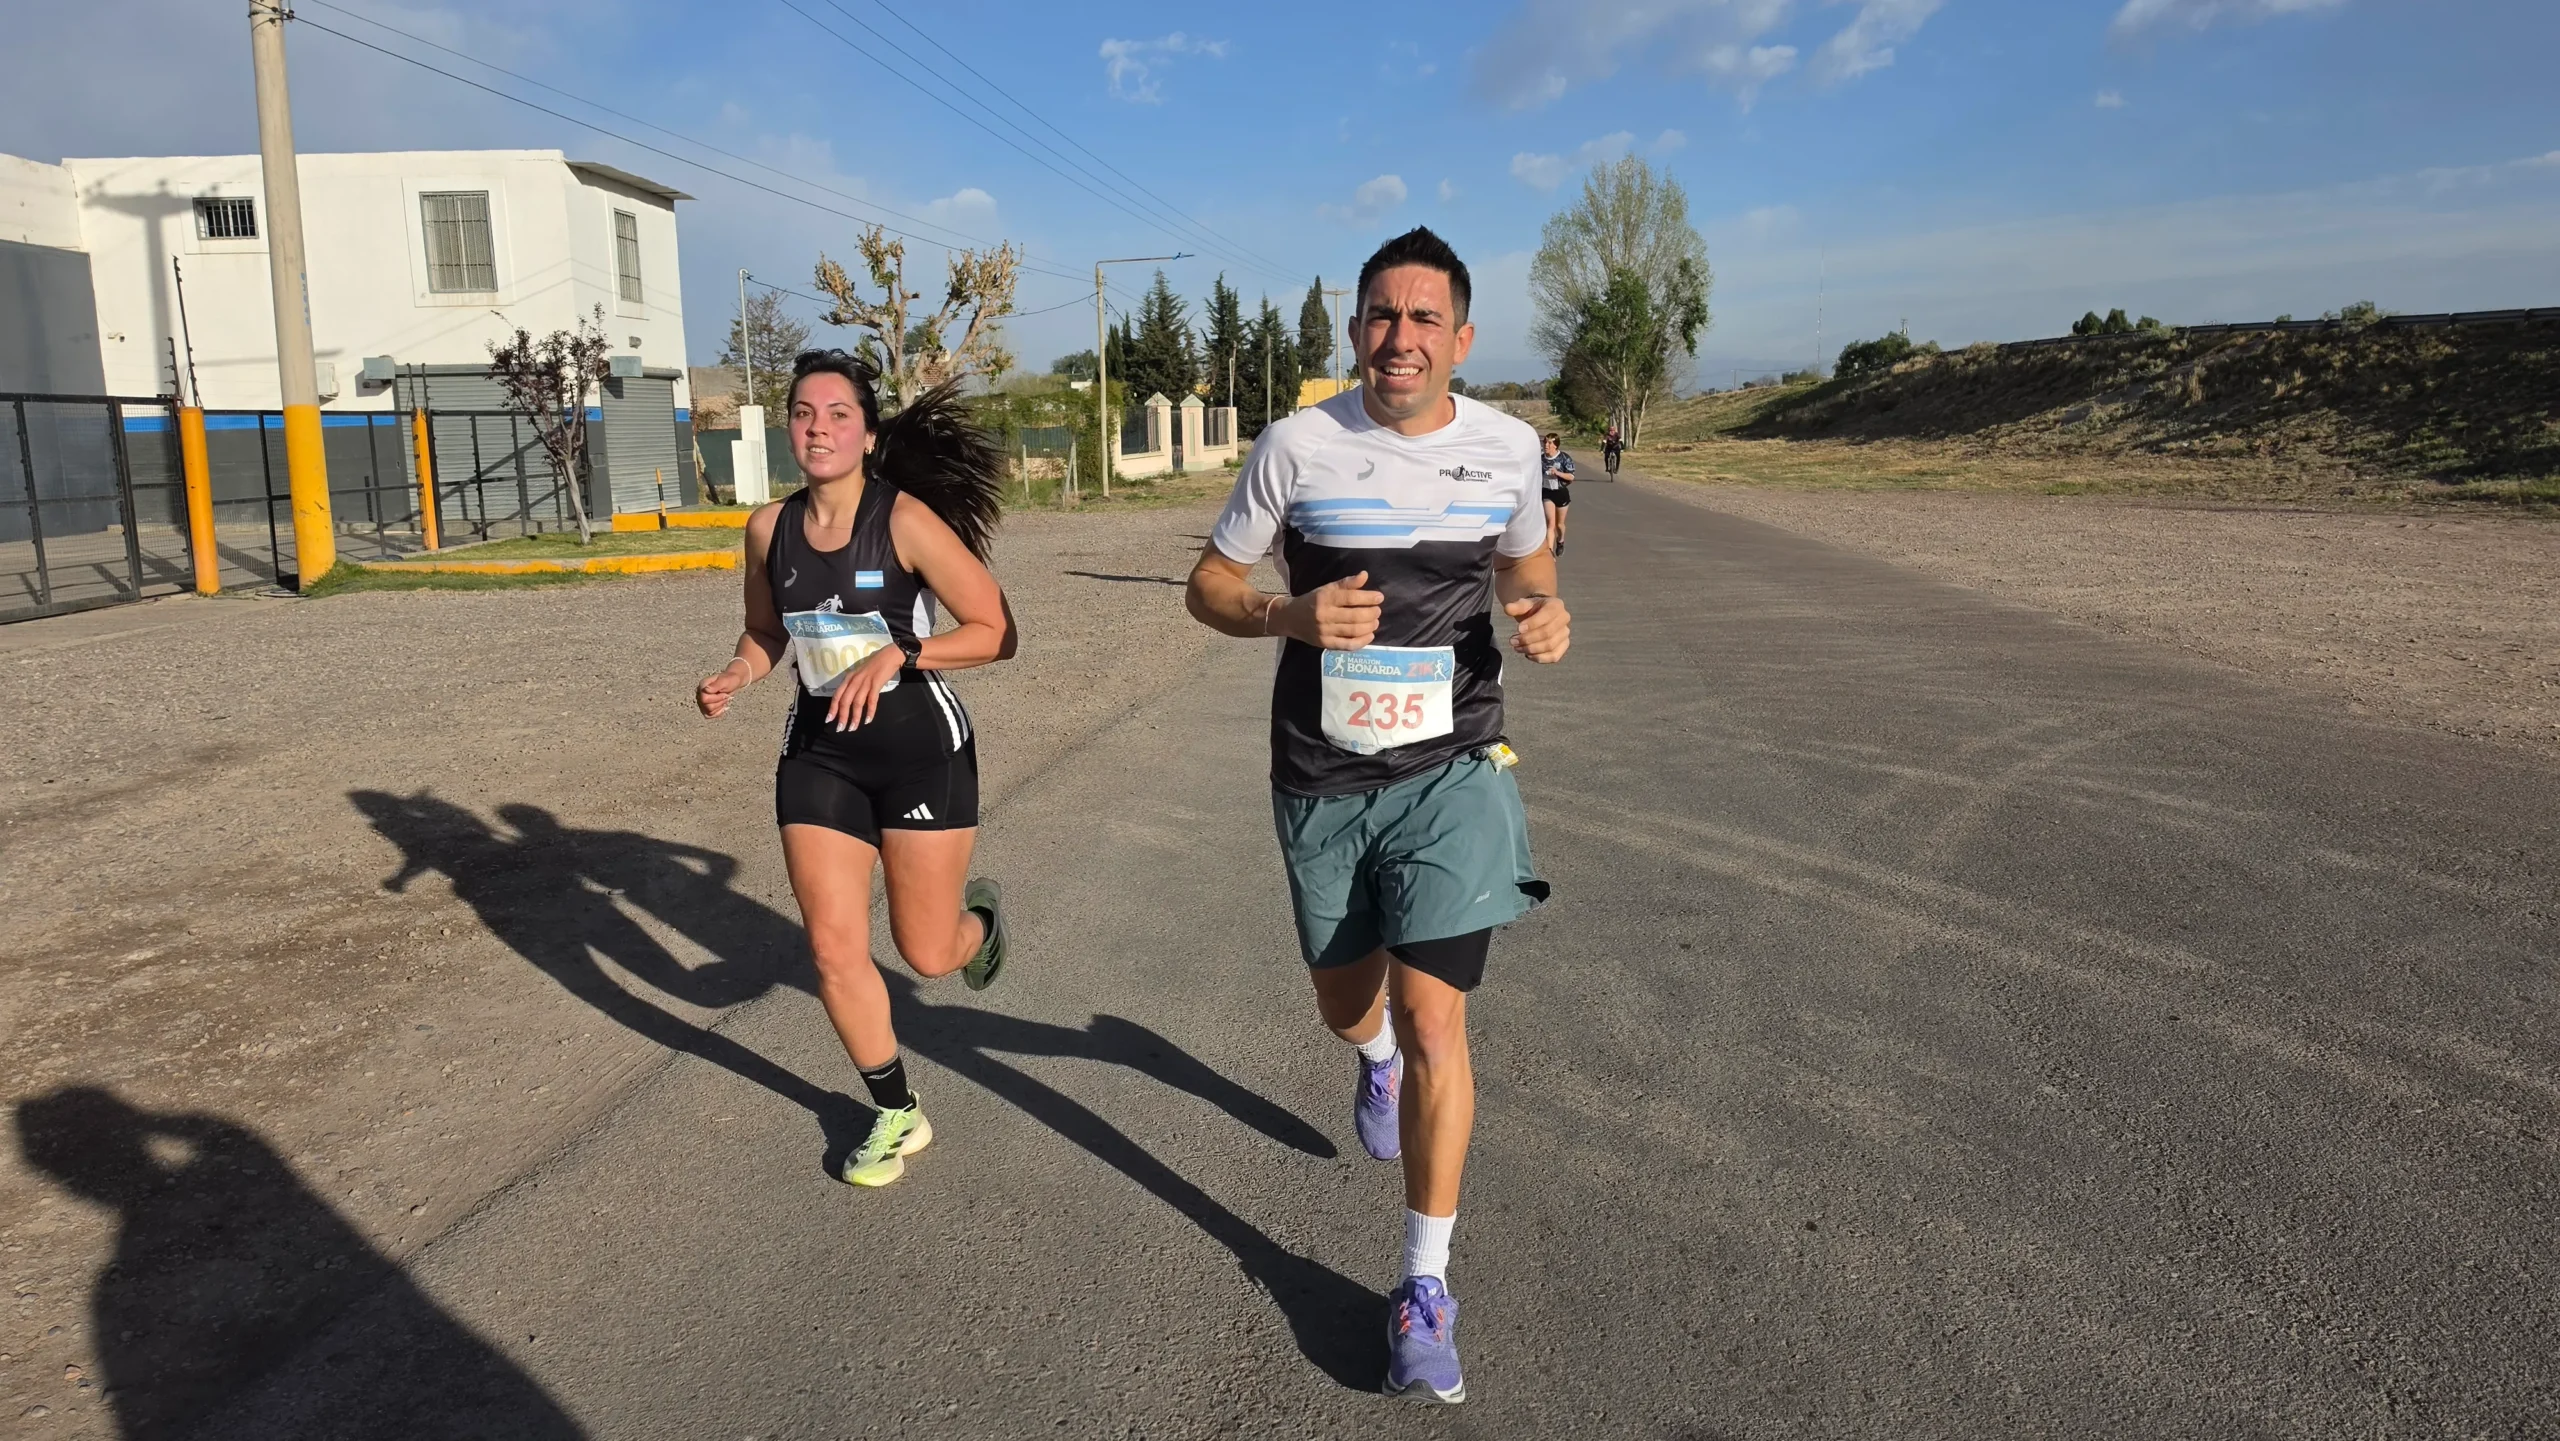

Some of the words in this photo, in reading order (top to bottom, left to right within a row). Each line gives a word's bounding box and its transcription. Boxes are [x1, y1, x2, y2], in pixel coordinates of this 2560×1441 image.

[804, 623, 844, 633] BONARDA
[1347, 663, 1401, 676] BONARDA
[1347, 691, 1424, 730] 235
